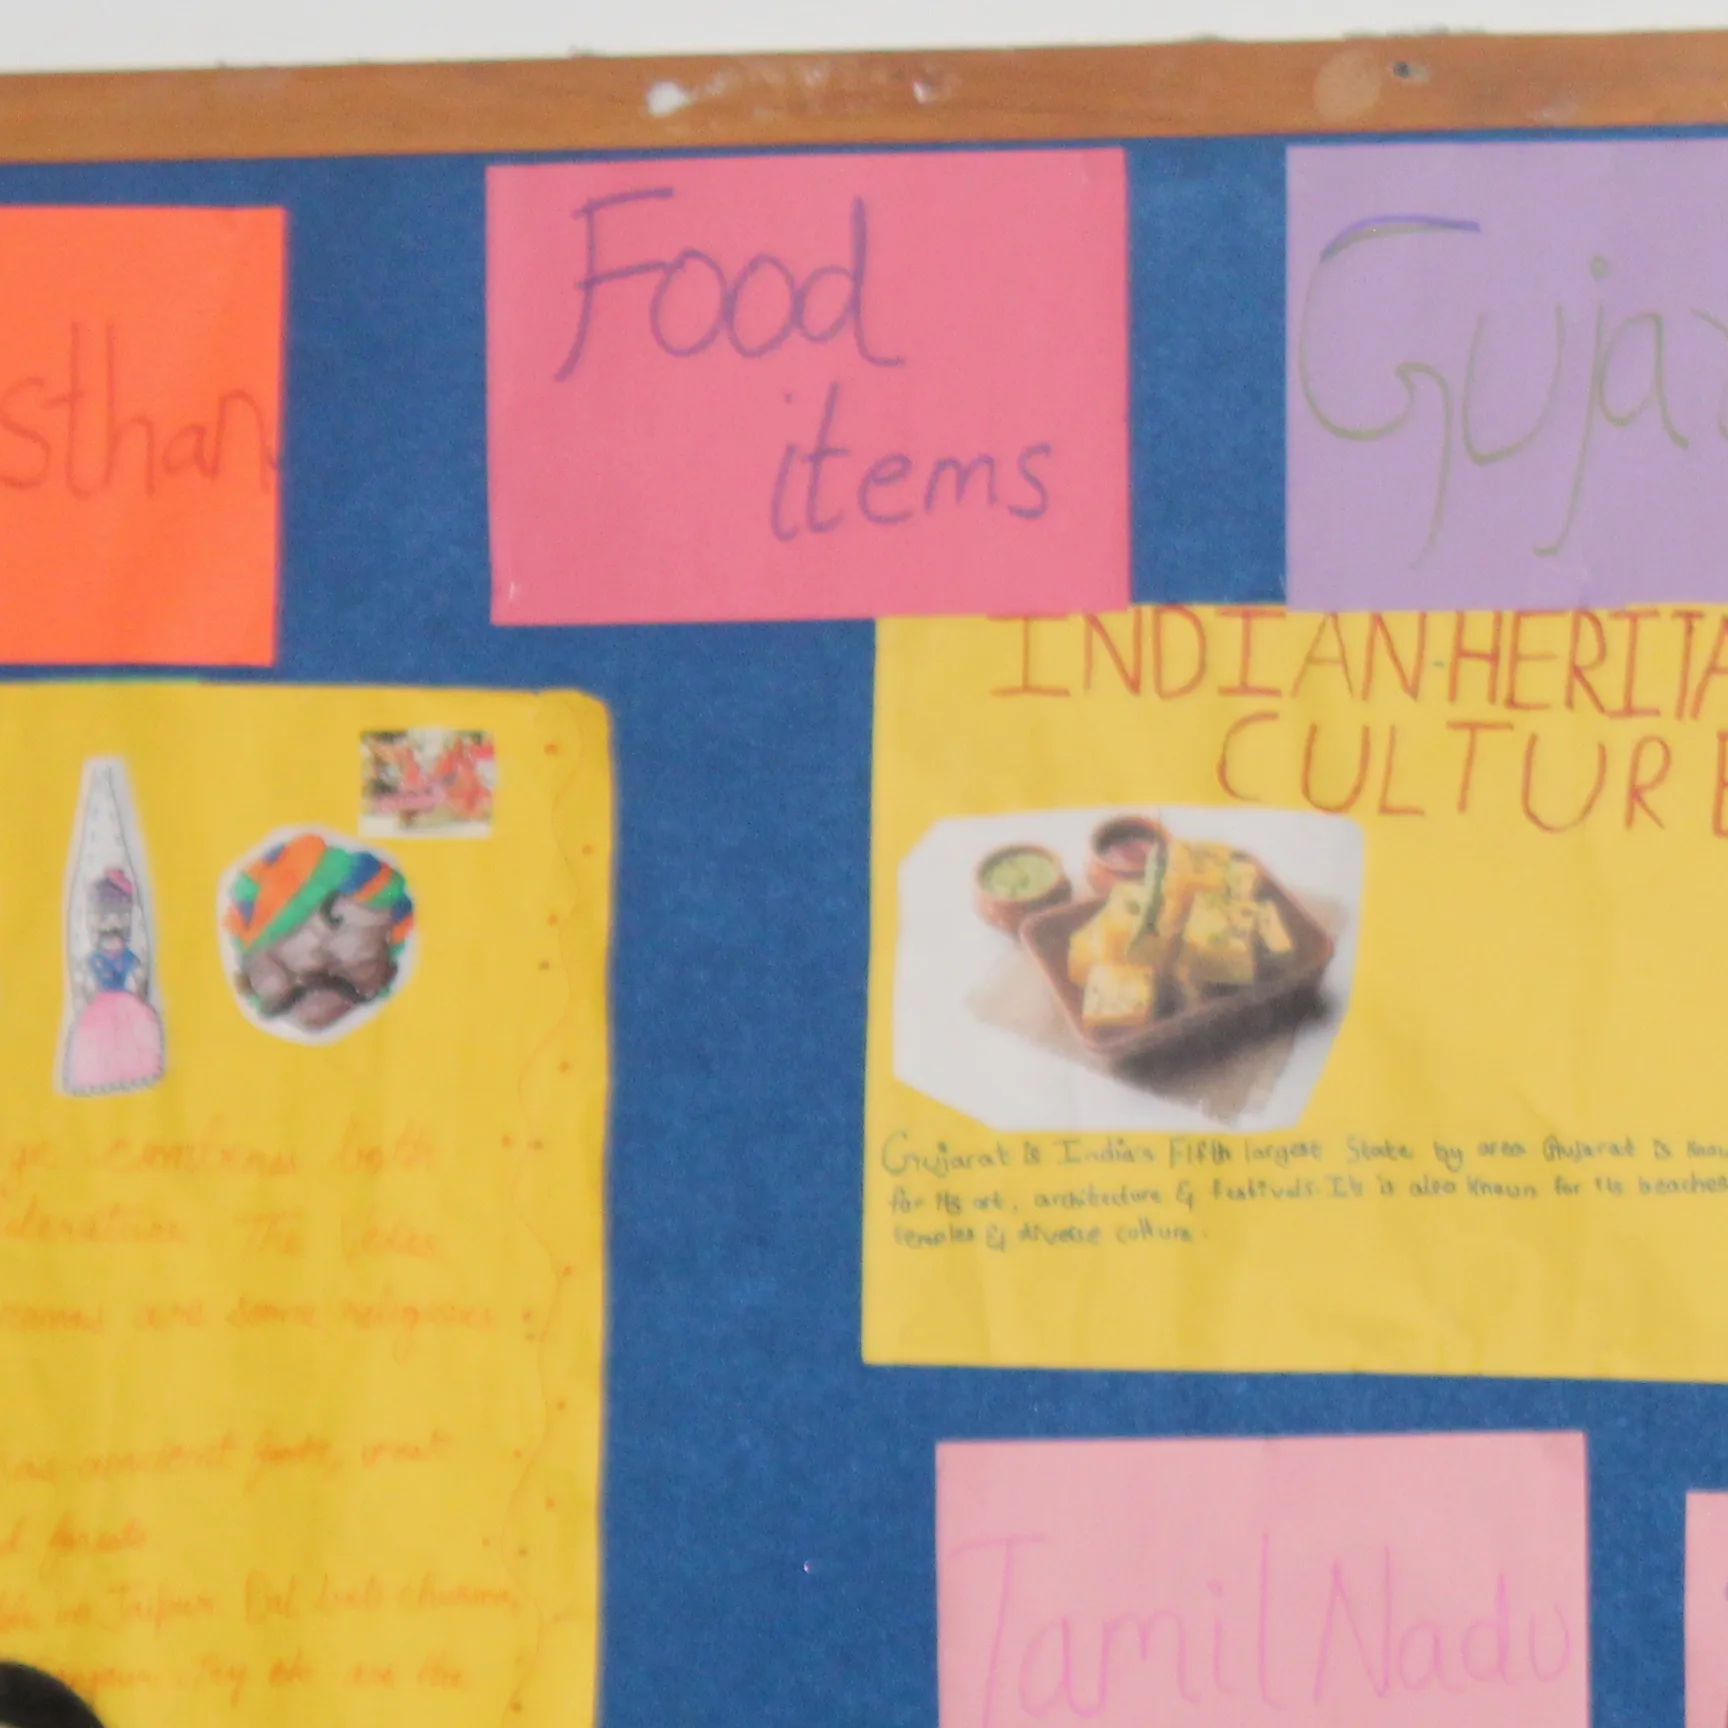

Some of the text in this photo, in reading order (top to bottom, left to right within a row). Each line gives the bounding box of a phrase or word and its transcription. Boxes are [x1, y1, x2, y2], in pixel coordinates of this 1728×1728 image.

[552, 187, 905, 383] Food
[770, 382, 1051, 542] items
[1314, 1544, 1571, 1704] Nadu
